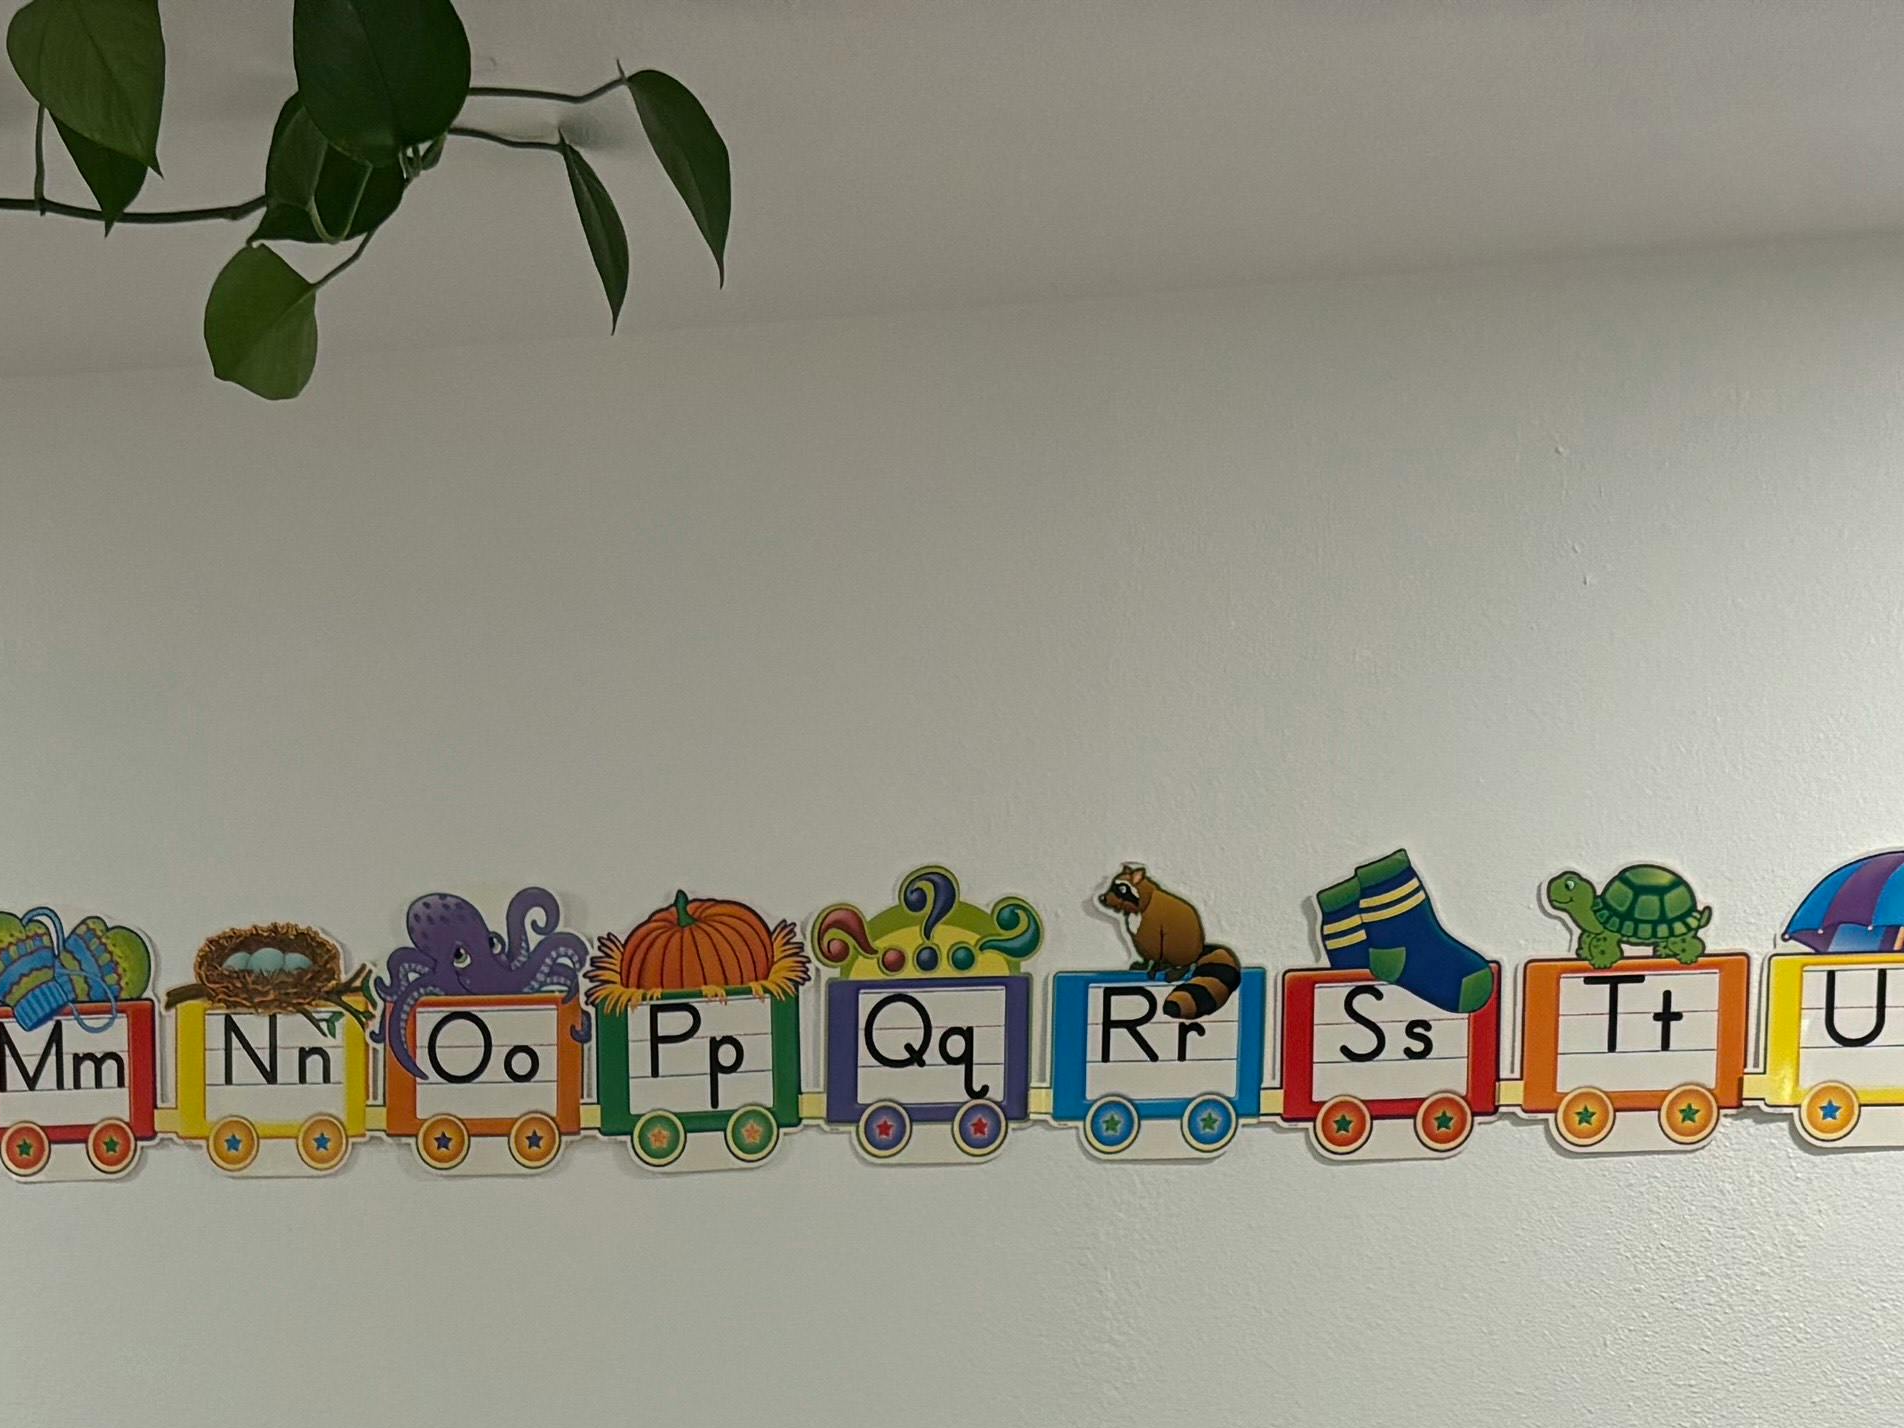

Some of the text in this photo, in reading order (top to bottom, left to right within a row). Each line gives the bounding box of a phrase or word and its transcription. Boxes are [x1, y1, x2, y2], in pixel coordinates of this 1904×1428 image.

[224, 1010, 333, 1086] Nn
[427, 1010, 540, 1085] Oo
[649, 1002, 744, 1110] Pp
[863, 992, 989, 1101] Qq
[1101, 985, 1206, 1063] Rr
[1339, 985, 1434, 1063] Ss
[1583, 974, 1683, 1054] Tt
